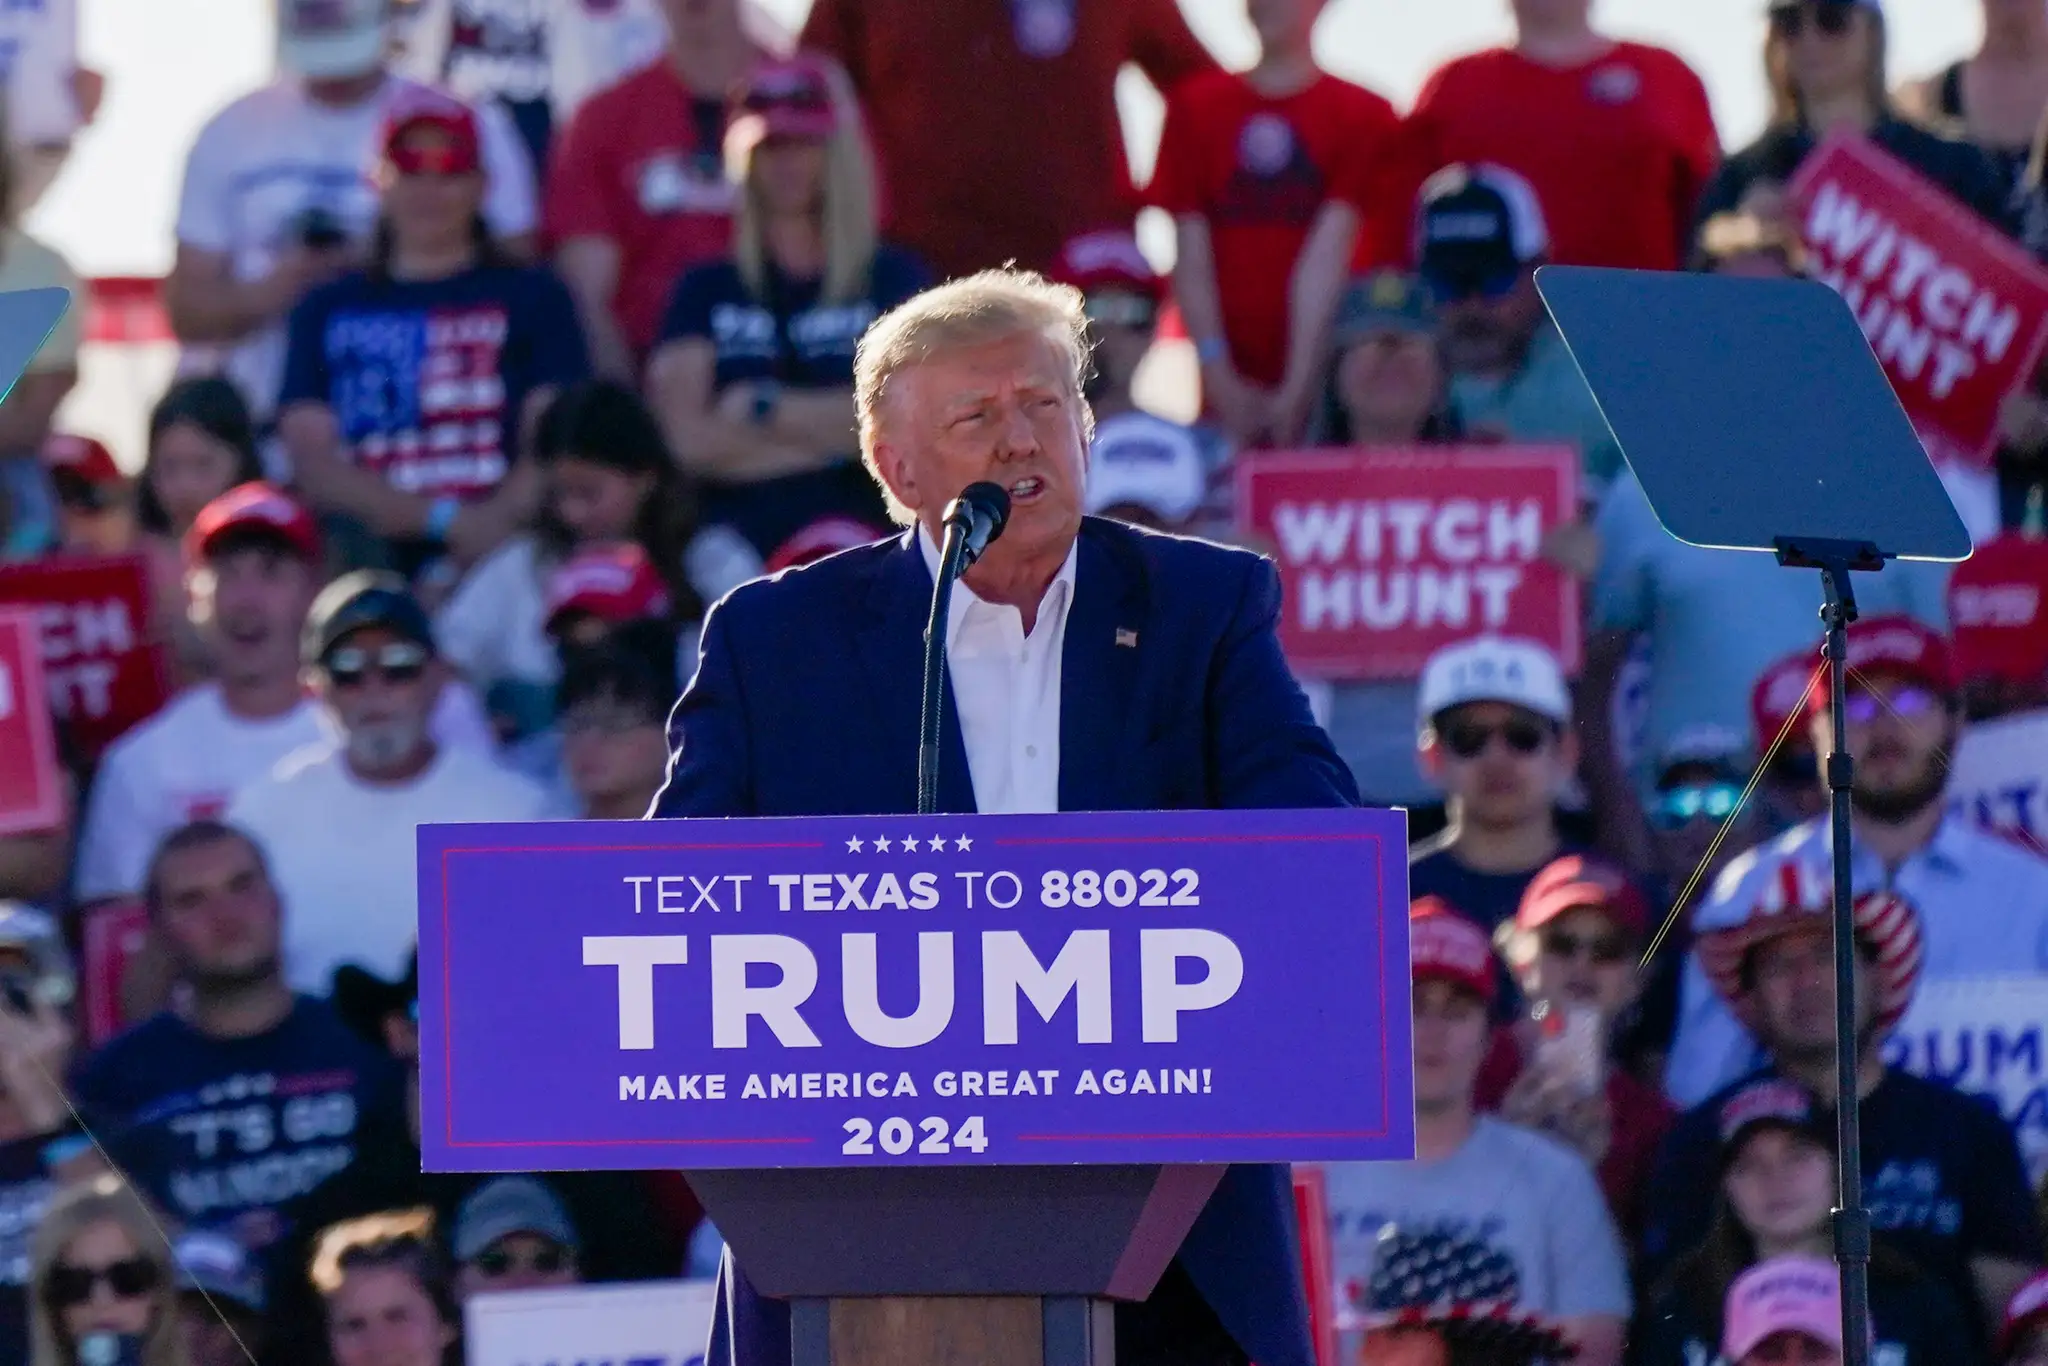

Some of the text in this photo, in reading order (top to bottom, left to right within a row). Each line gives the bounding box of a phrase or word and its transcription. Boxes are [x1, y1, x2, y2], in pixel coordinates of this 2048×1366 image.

[1805, 181, 2018, 363] WITCH
[1274, 501, 1542, 566] WITCH
[1300, 568, 1522, 630] HUNT
[623, 867, 1201, 914] TEXT TEXAS TO 88022
[582, 929, 1244, 1051] TRUMP
[618, 1068, 1213, 1102] MAKE AMERICA GREAT AGAIN!
[842, 1116, 990, 1155] 2024
